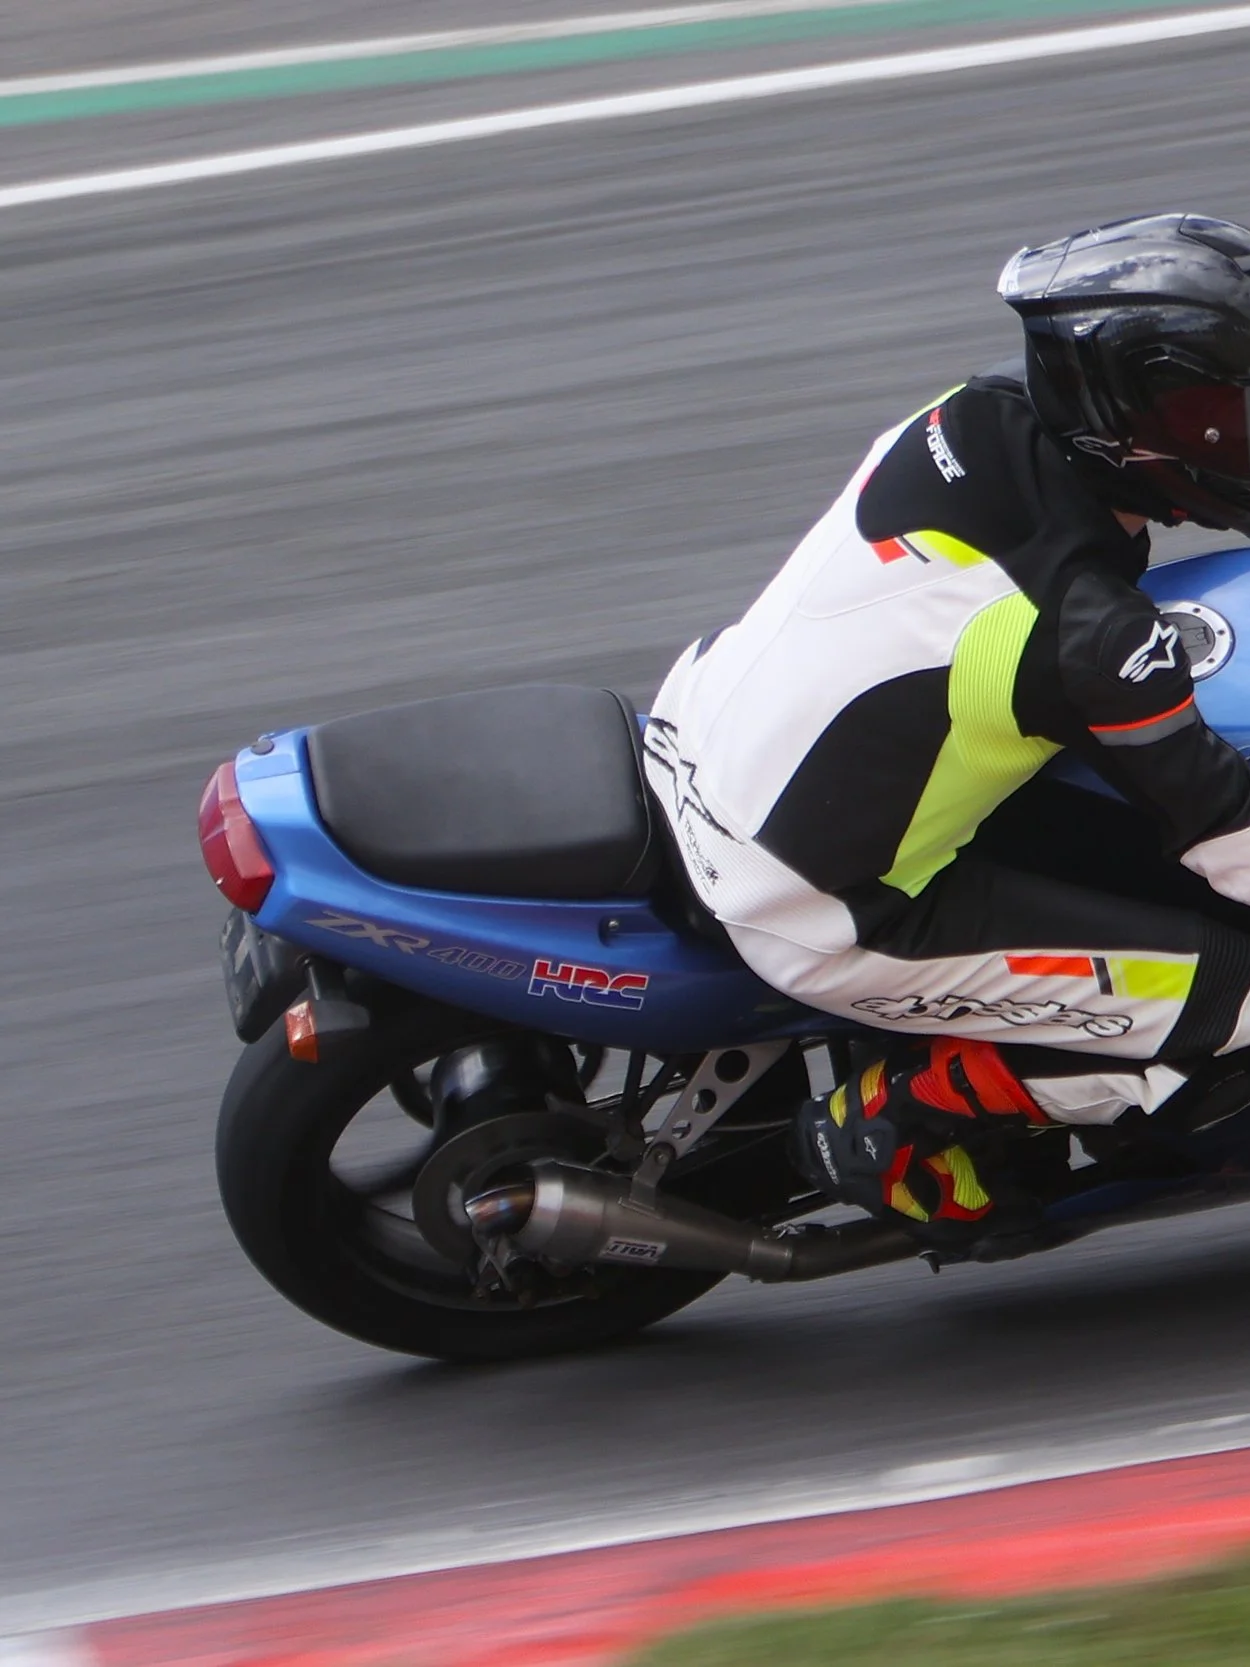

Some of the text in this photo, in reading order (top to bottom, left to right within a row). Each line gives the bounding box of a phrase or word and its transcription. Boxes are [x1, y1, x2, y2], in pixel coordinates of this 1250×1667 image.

[925, 424, 961, 483] FORCE
[303, 910, 528, 981] ZXR 400
[527, 958, 650, 1012] HRC
